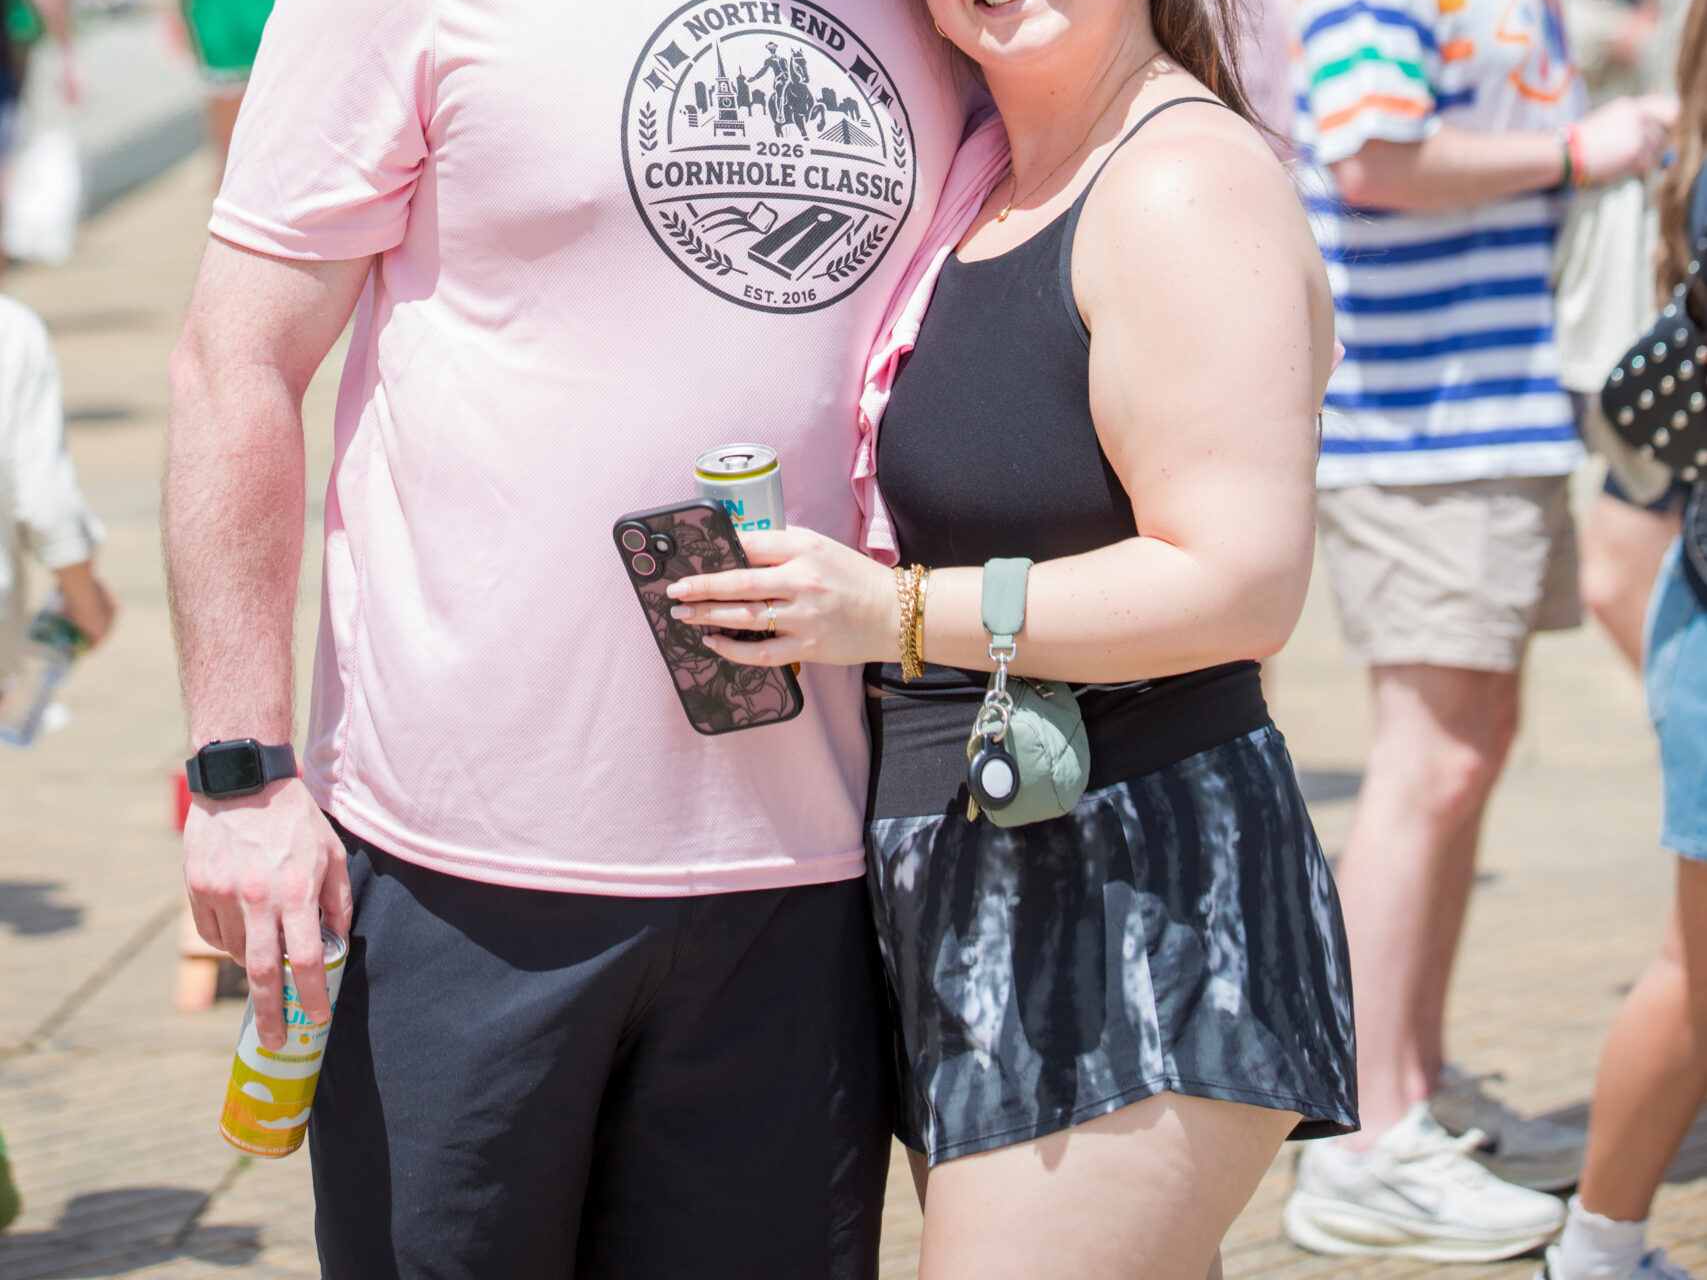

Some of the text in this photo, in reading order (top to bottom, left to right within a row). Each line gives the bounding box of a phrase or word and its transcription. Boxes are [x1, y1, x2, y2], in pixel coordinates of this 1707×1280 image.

[684, 1, 846, 52] NORTH END
[756, 142, 804, 158] 2026
[645, 161, 904, 206] CORNHOLE CLASSIC
[743, 284, 817, 305] EST. 2016
